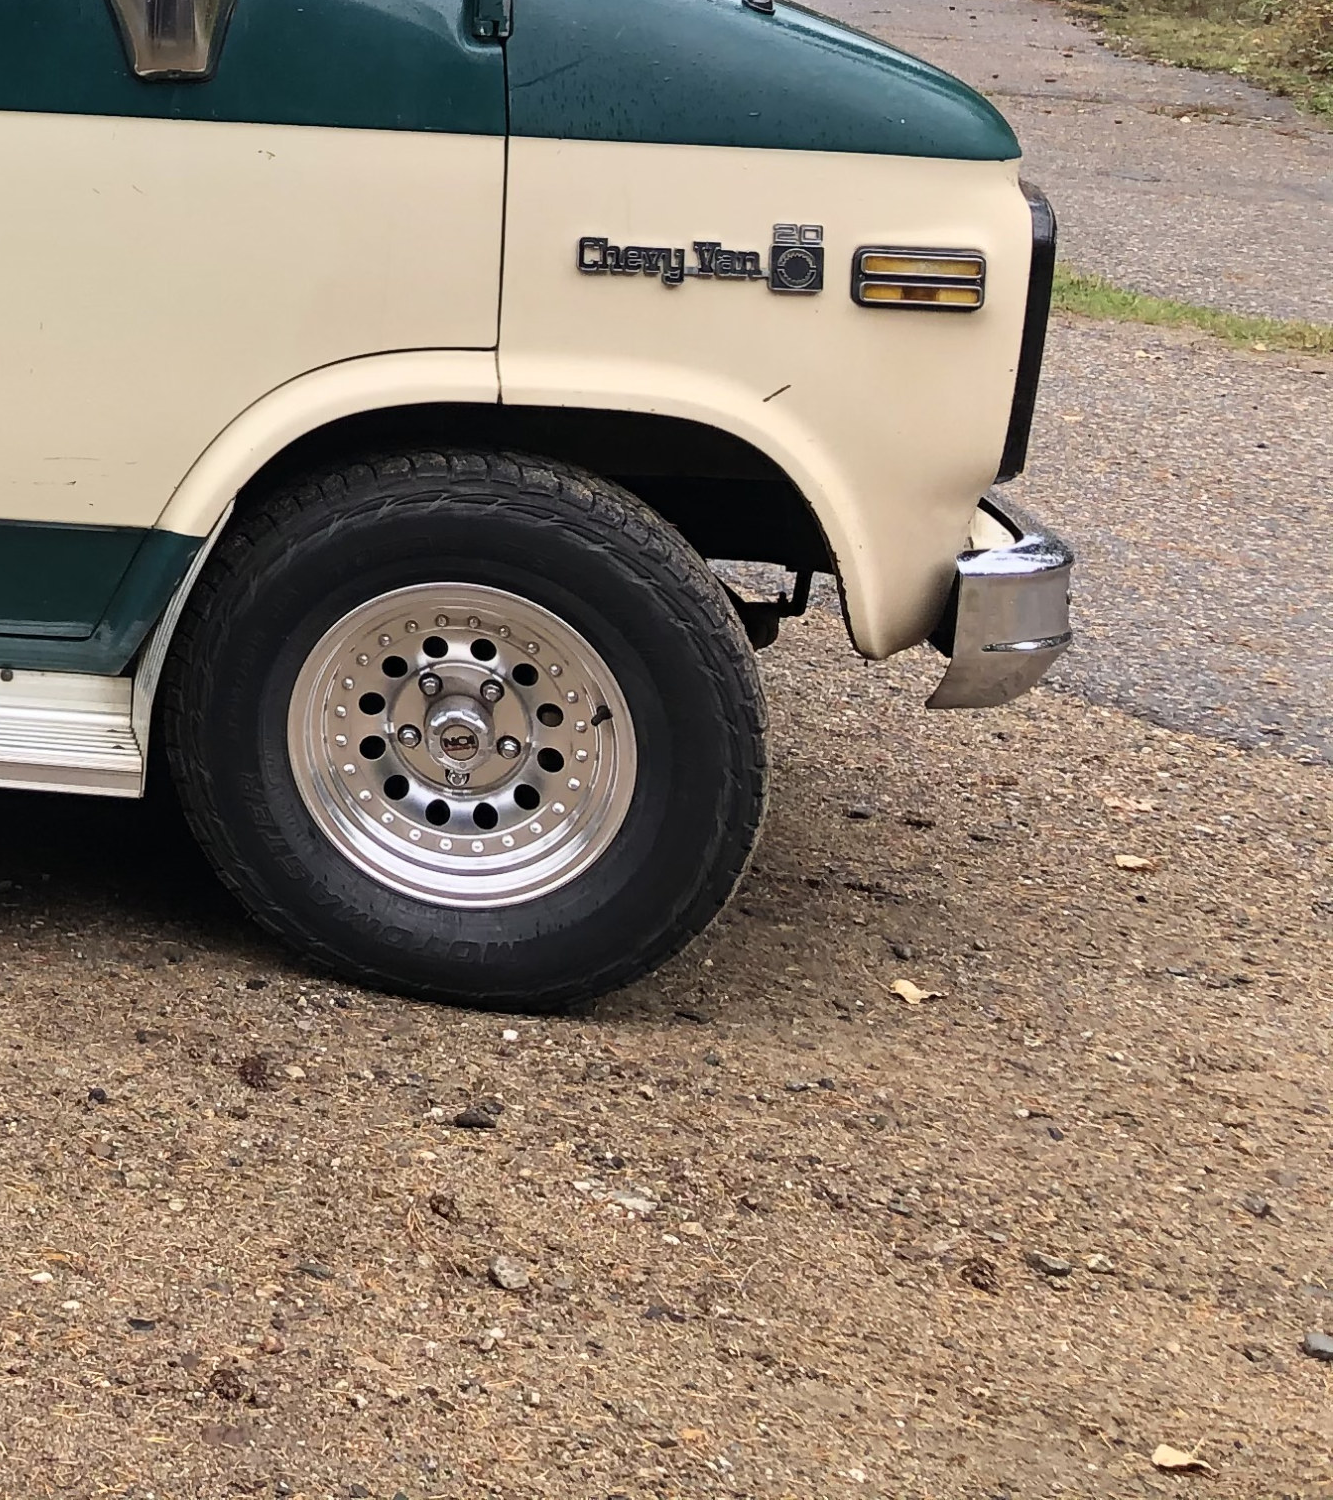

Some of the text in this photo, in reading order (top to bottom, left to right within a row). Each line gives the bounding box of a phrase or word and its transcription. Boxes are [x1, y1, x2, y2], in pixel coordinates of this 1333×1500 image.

[773, 223, 824, 245] 20
[576, 237, 763, 285] Chevy Van
